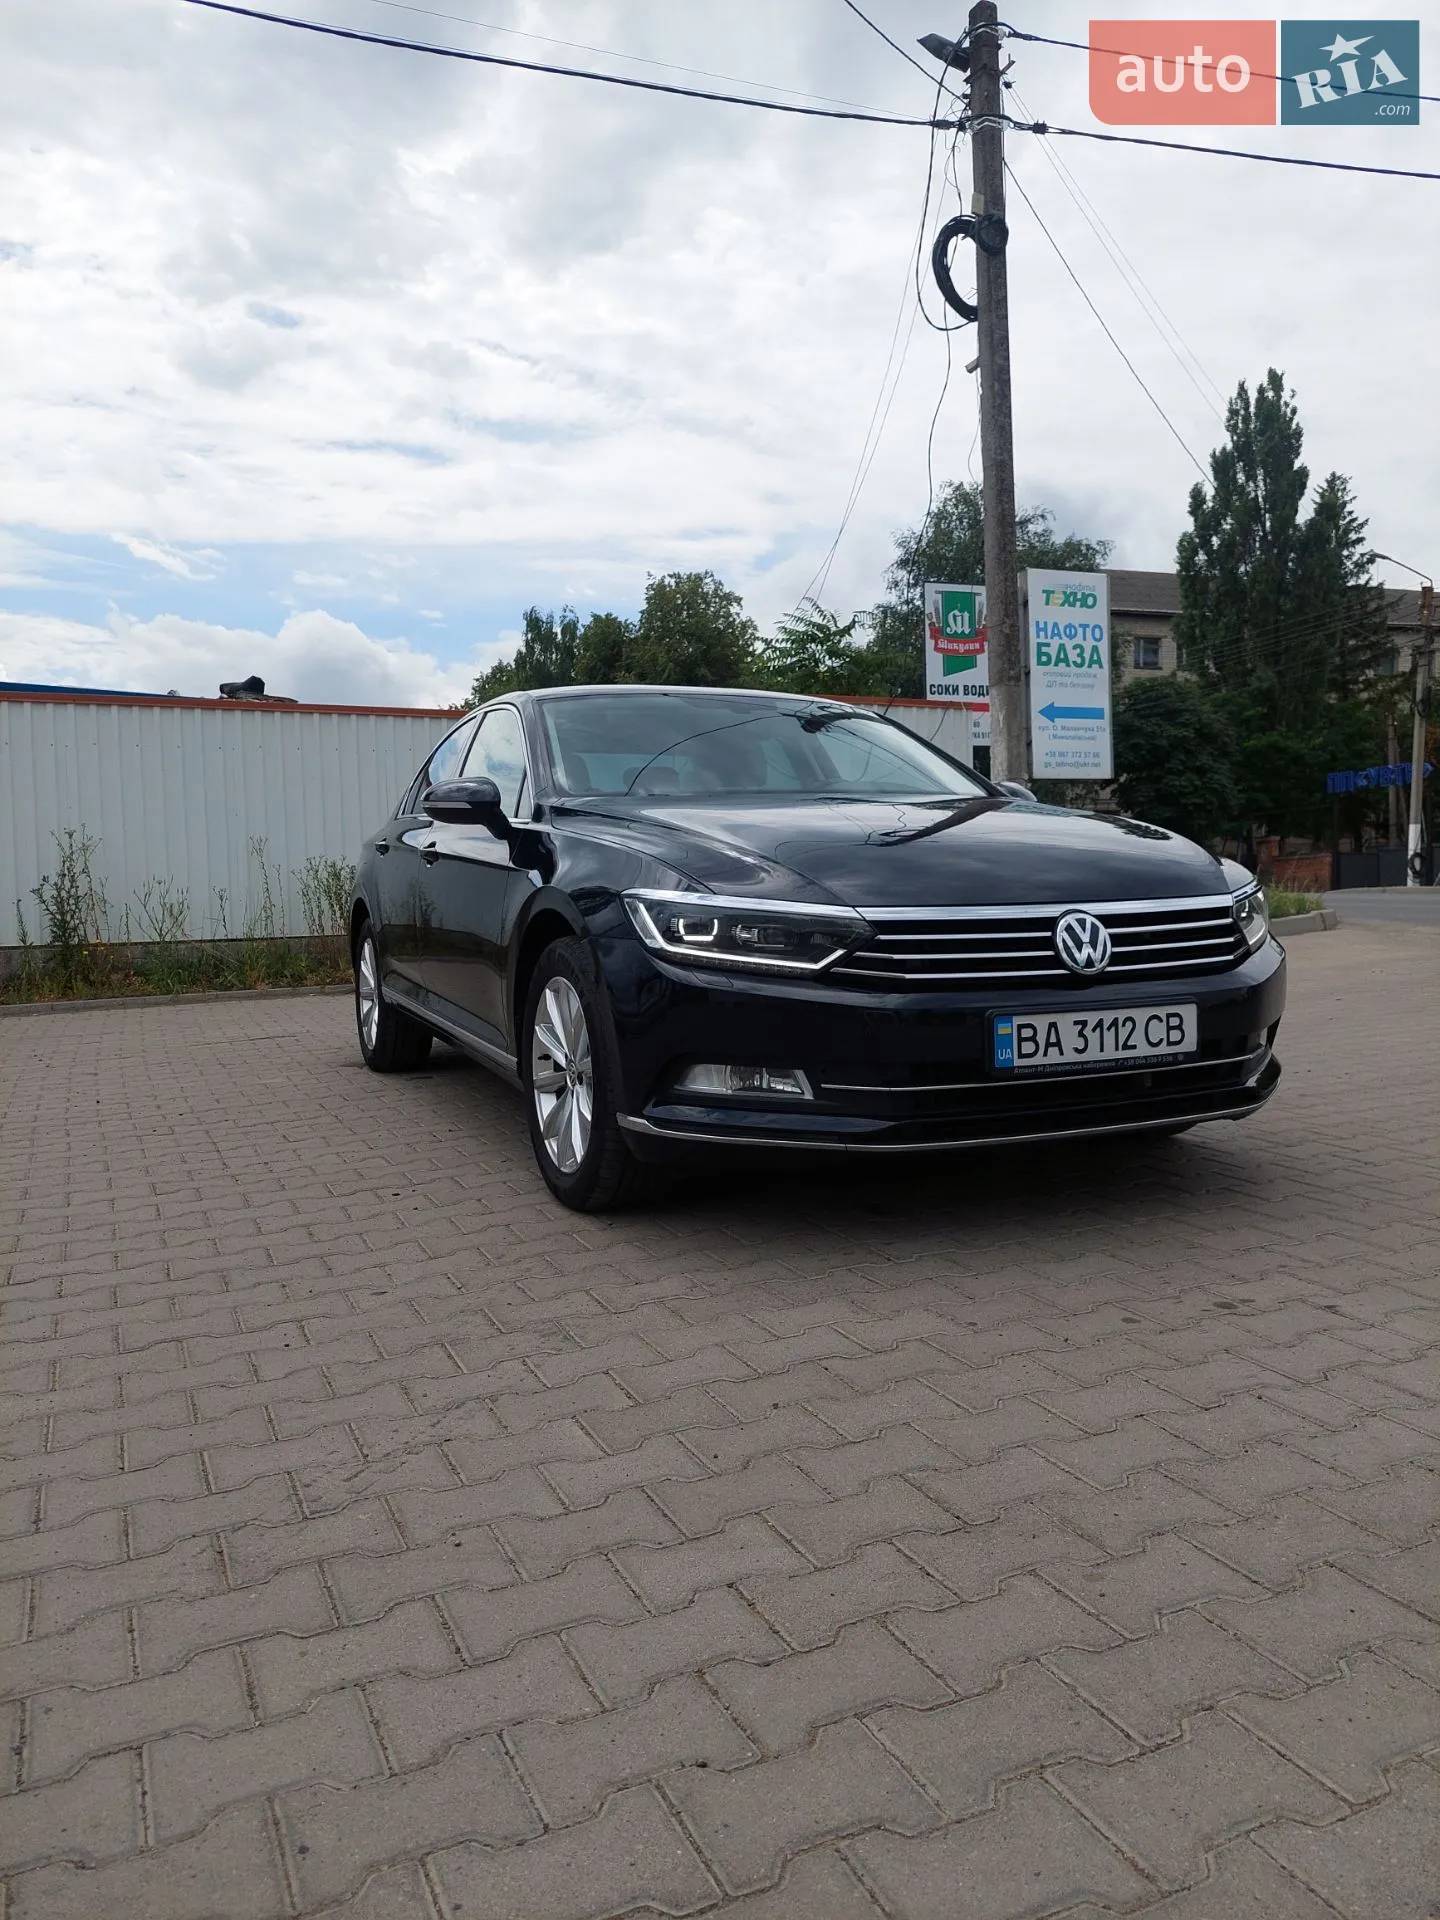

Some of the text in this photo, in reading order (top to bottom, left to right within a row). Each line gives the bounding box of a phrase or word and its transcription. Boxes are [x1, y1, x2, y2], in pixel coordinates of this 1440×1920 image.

[1035, 620, 1105, 643] НАФТО
[1036, 641, 1105, 670] БАЗА
[929, 683, 960, 696] СОКИ
[1016, 1012, 1187, 1060] BA 3112 CB
[998, 1048, 1013, 1061] UA
